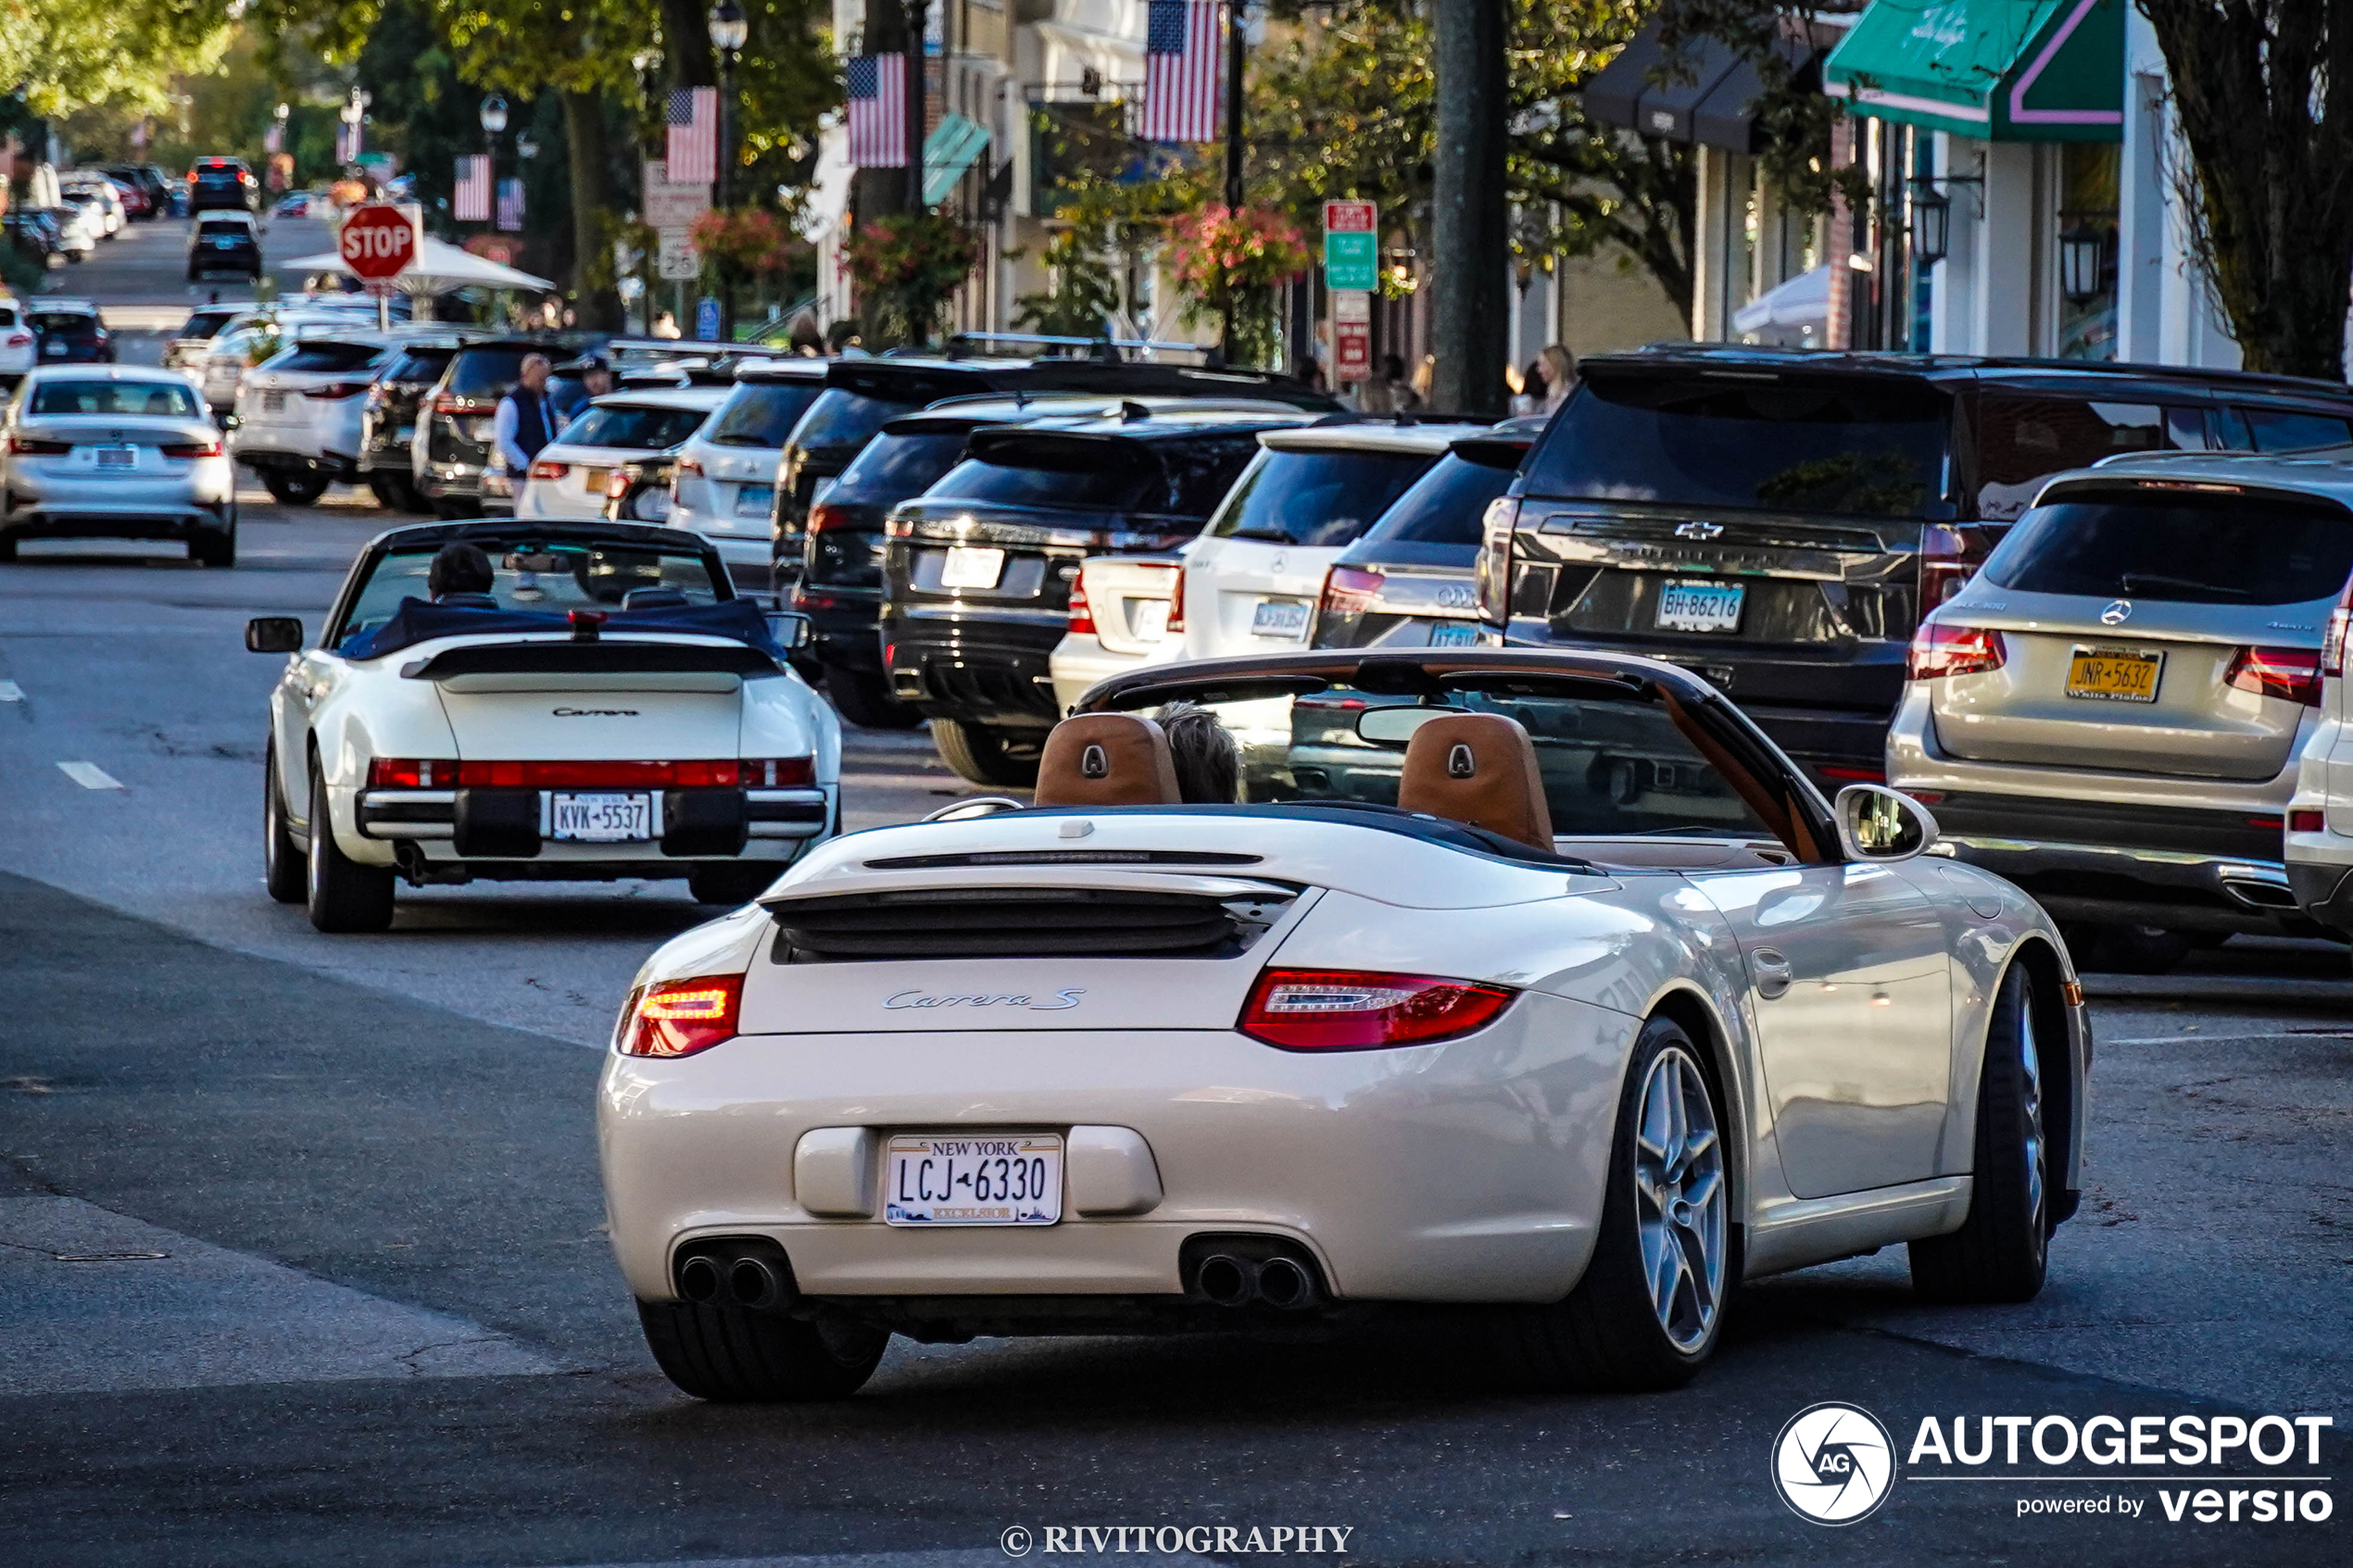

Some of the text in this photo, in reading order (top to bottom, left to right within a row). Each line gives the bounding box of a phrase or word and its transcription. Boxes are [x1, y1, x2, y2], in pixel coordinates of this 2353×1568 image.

[344, 225, 412, 258] STOP
[552, 707, 640, 717] Carrera
[882, 987, 1087, 1010] Carrera S
[932, 1141, 1019, 1156] NEW YORK
[933, 1208, 1011, 1220] EXCELSIOR
